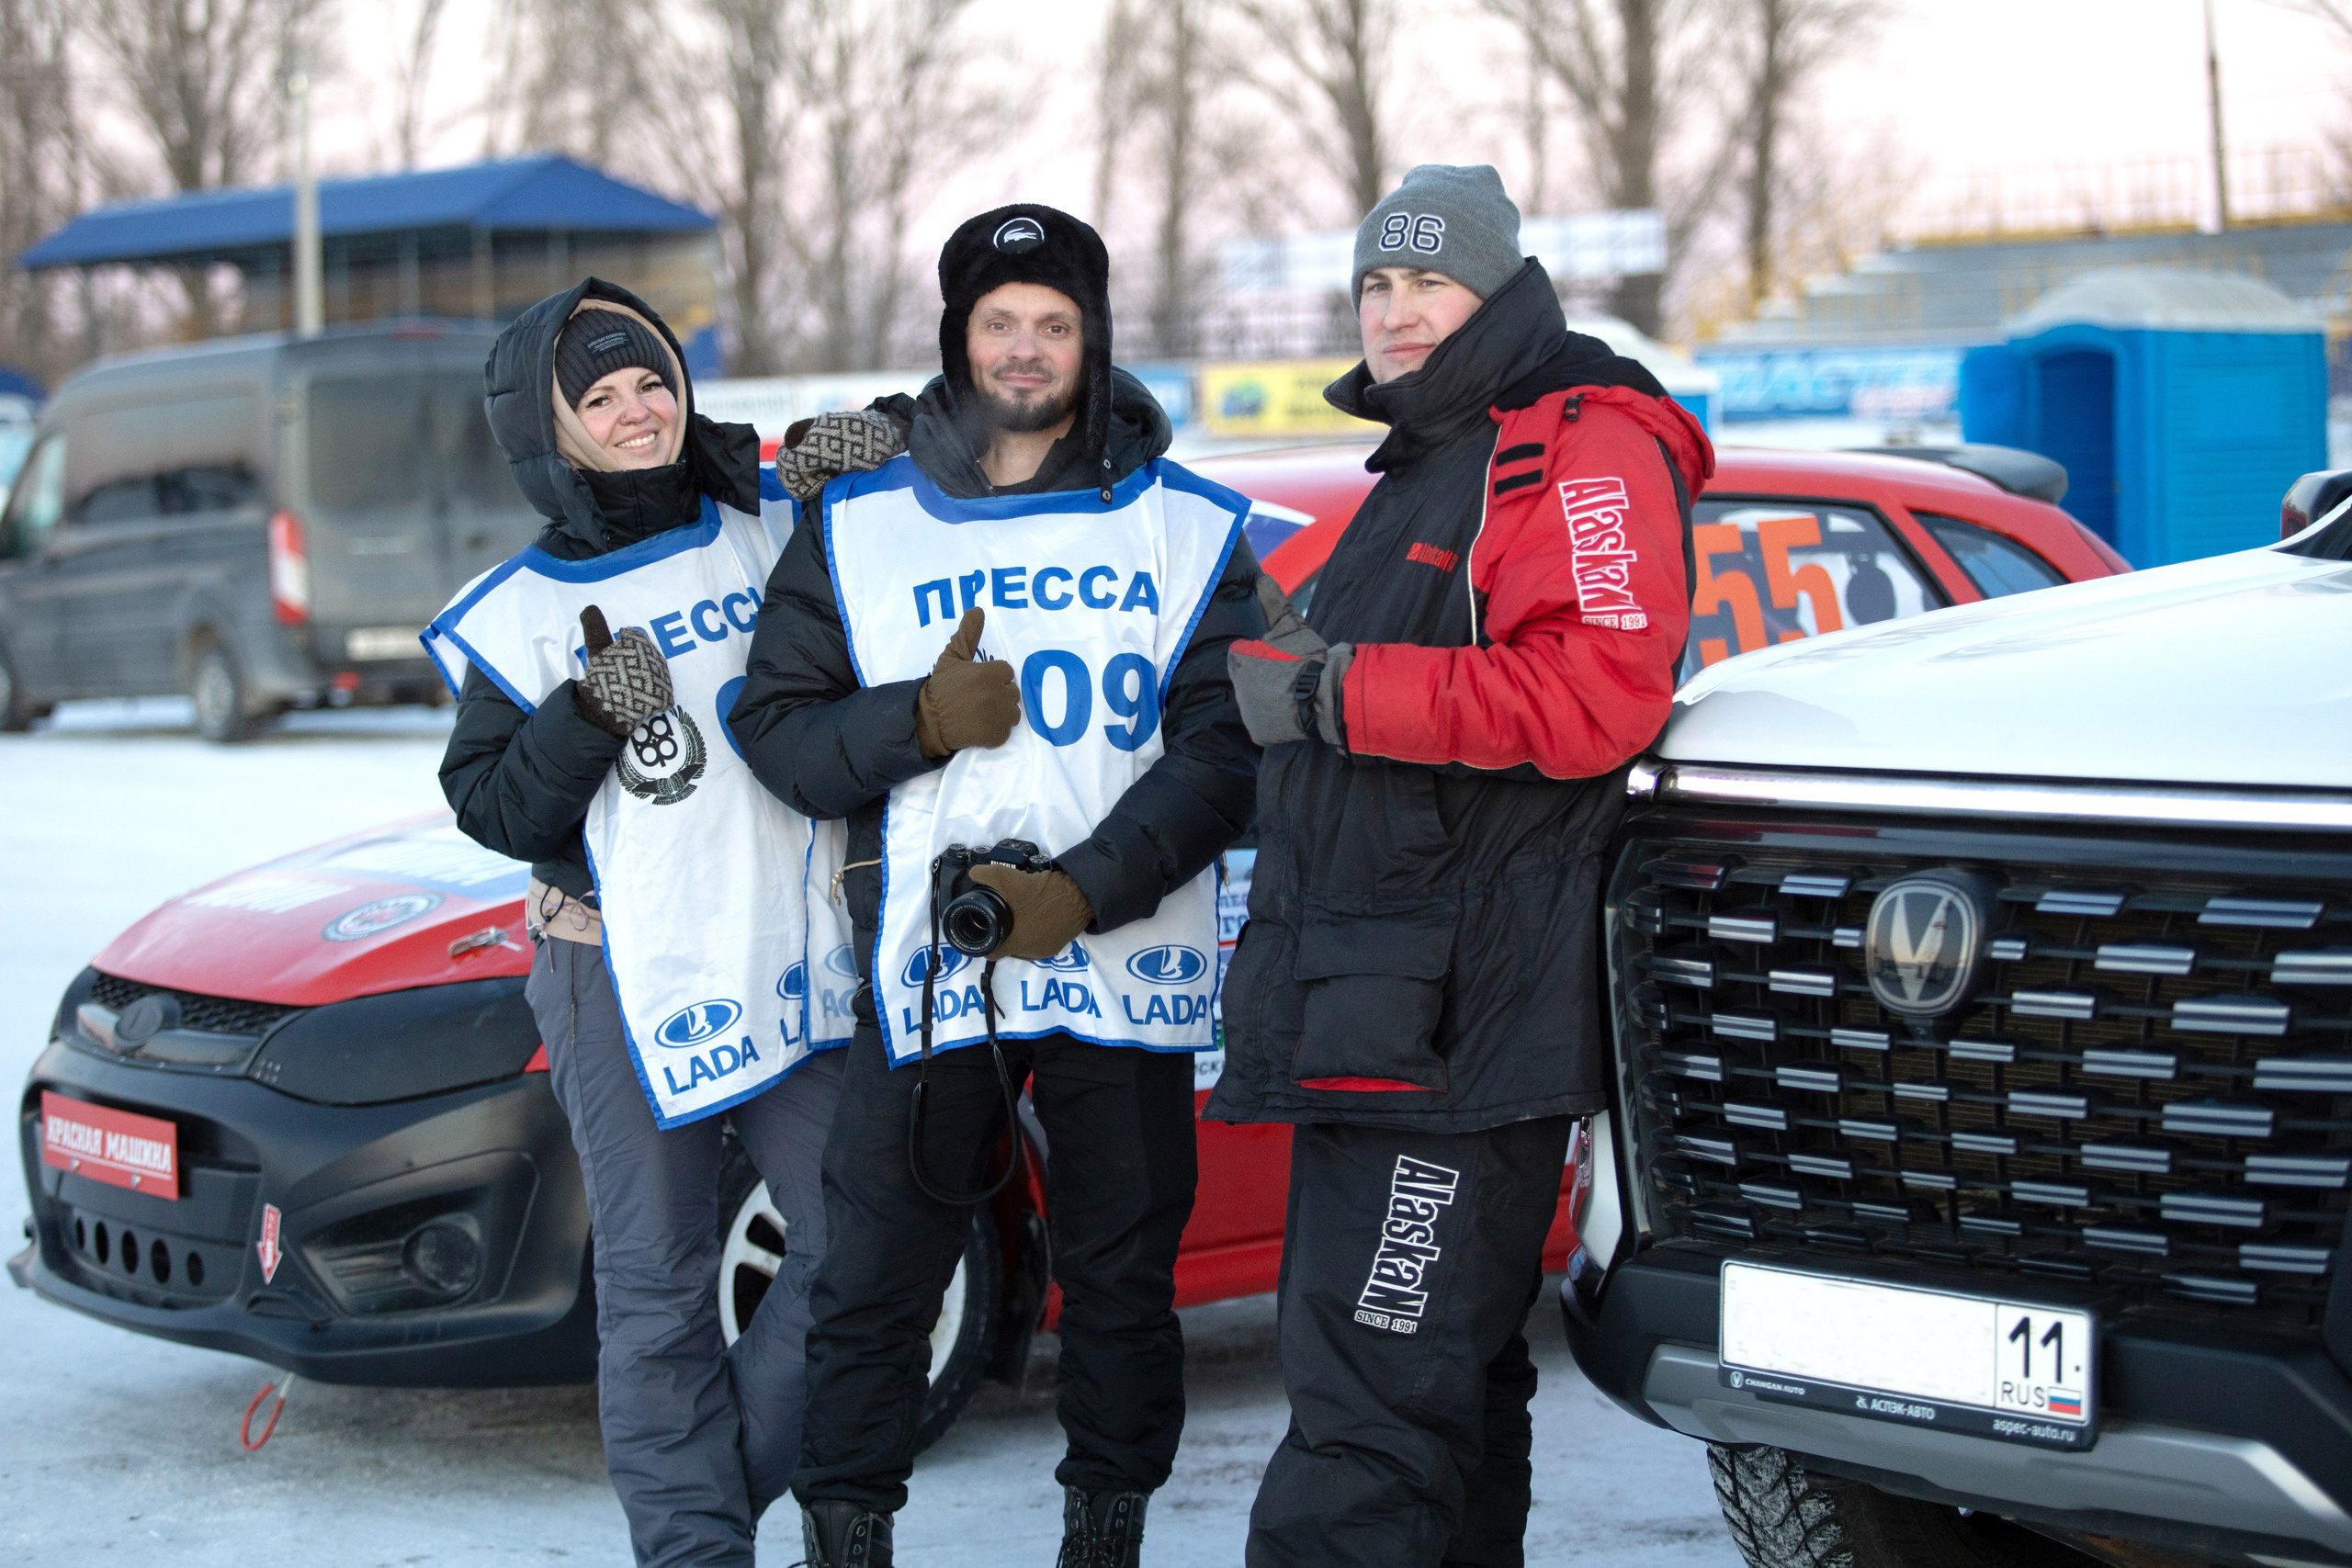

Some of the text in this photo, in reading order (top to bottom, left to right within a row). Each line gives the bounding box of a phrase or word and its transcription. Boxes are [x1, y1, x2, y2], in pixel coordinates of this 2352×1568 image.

[1379, 212, 1445, 254] 86
[912, 565, 1159, 628] ПРЕССА
[1692, 516, 1845, 669] 55
[574, 586, 763, 672] ЕСС
[1582, 614, 1647, 630] SINCE 1991
[1021, 649, 1160, 752] 09
[1021, 977, 1102, 1019] LADA
[1122, 994, 1207, 1025] LADA
[663, 1035, 761, 1096] LADA
[47, 1114, 172, 1173] КРАСНАЯ МАШИНА
[1354, 1310, 1418, 1334] SINCE 1991
[2008, 1316, 2063, 1383] 11
[1745, 1378, 1805, 1395] CHANGAN AUTO
[1870, 1398, 1936, 1421] АСПЭК-АВТО
[2001, 1381, 2045, 1407] RUS
[1992, 1418, 2076, 1442] aspec-auto.ru
